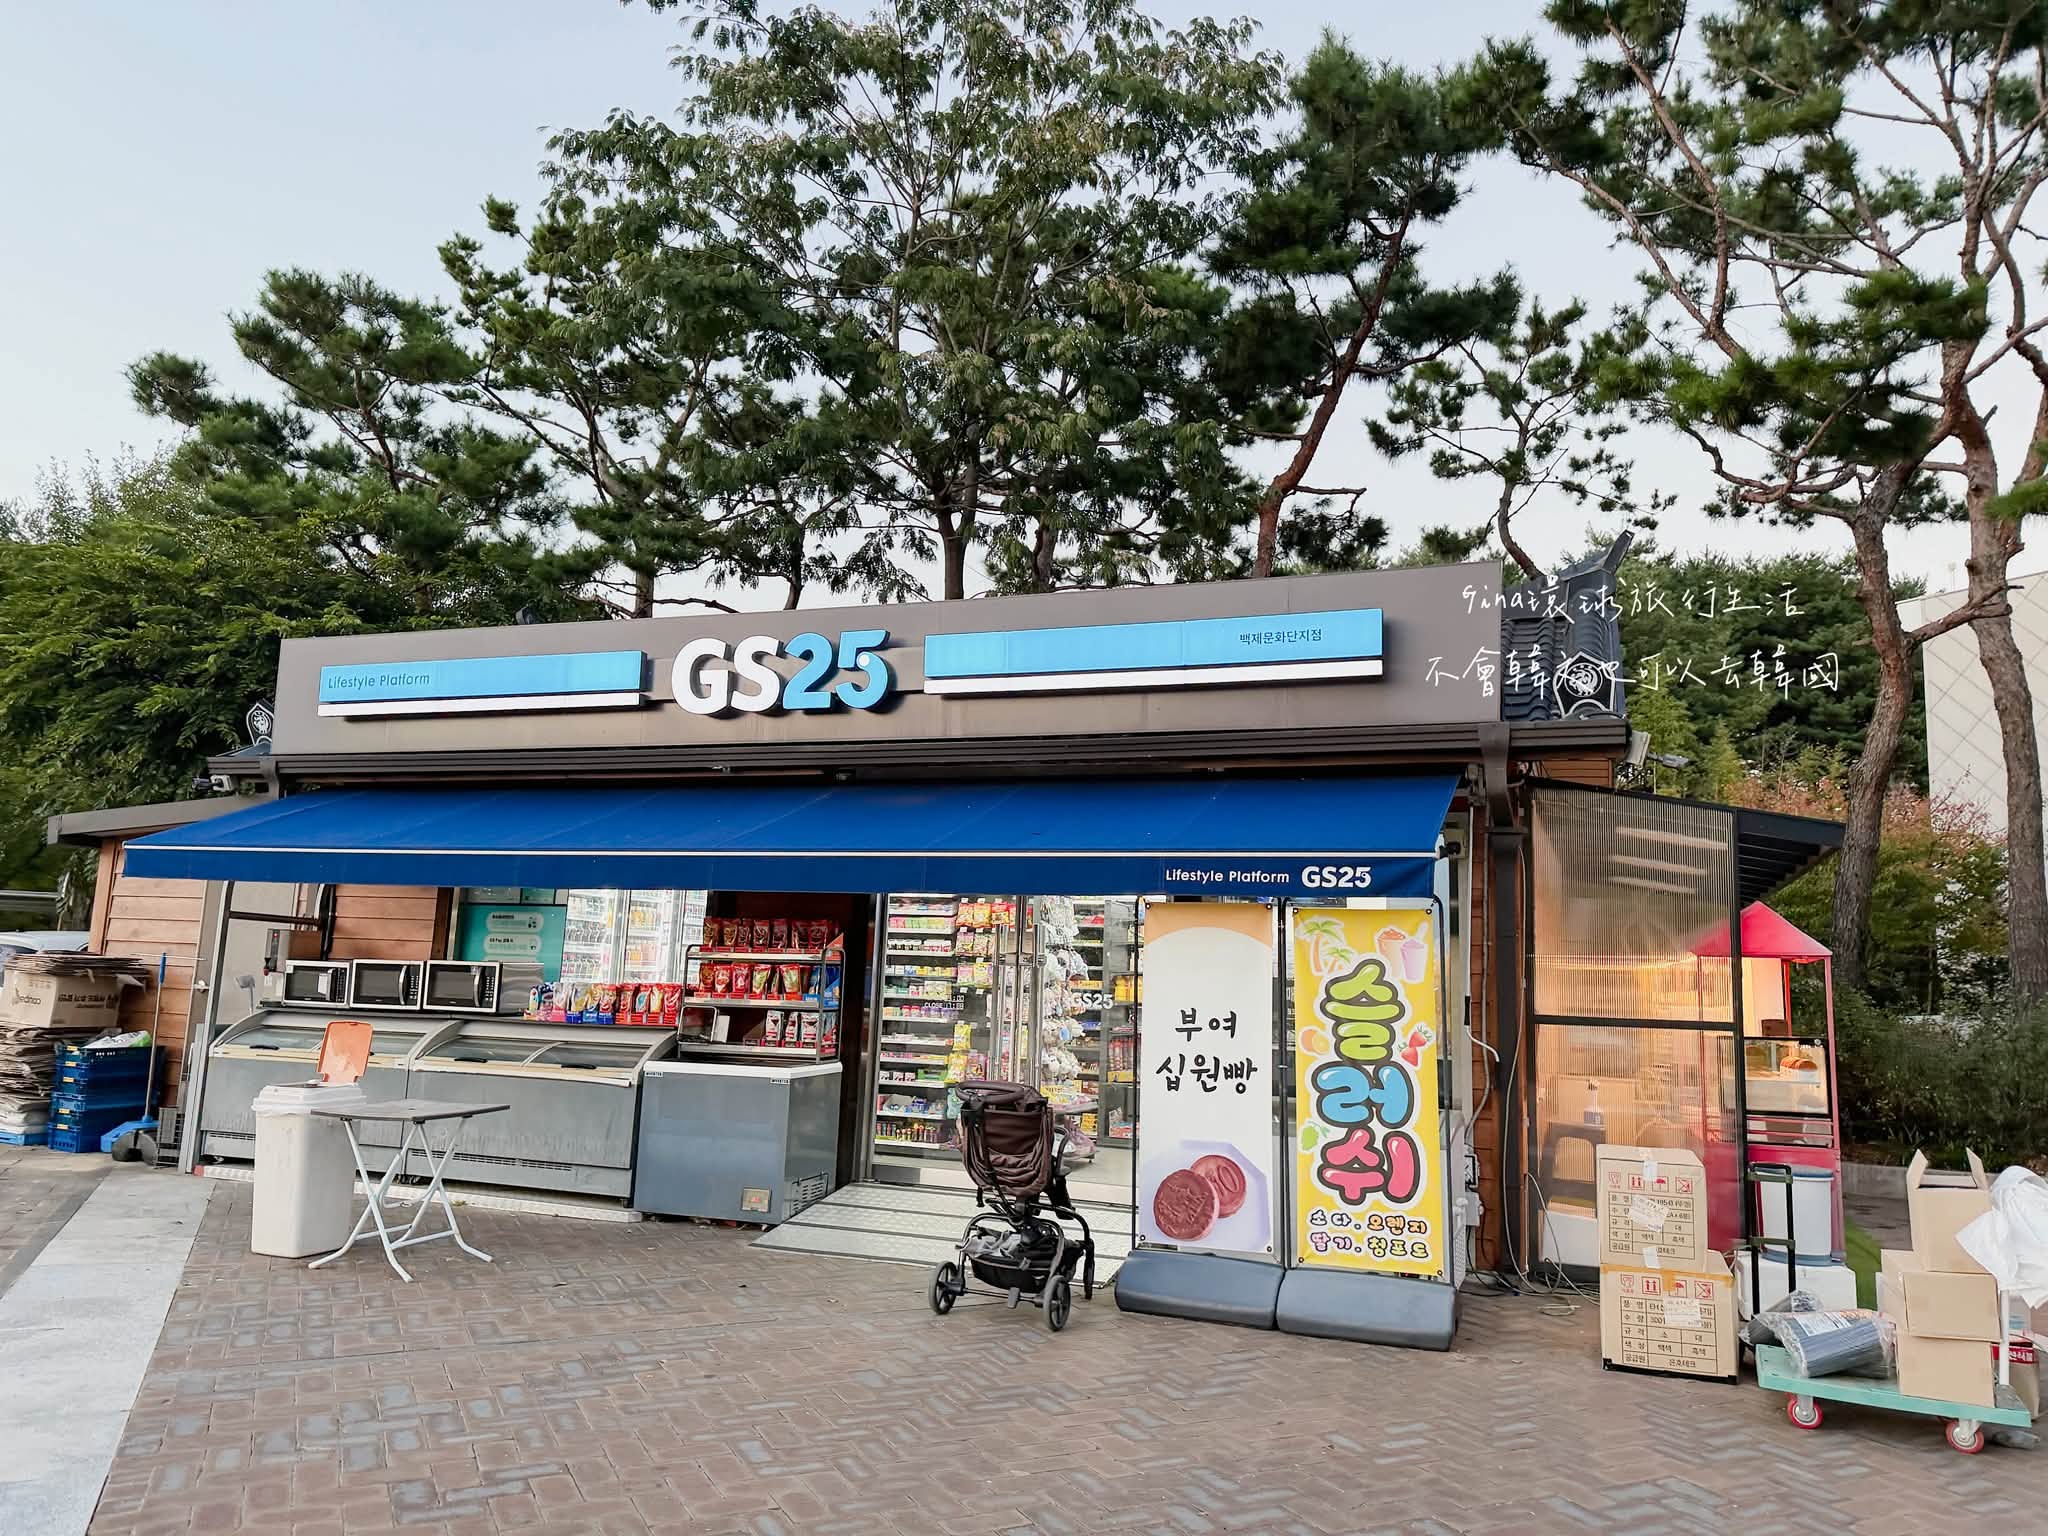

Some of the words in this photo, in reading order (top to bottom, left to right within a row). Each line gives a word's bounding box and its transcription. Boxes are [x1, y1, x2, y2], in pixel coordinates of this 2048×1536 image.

[1240, 628, 1322, 645] 백제문화단지점
[328, 675, 376, 690] Lifestyle
[379, 673, 430, 687] Platform
[671, 630, 889, 715] GS25
[1165, 868, 1224, 885] Lifestyle
[1229, 869, 1290, 883] Platform
[1301, 866, 1372, 888] GS25
[1071, 992, 1114, 1010] GS25
[1175, 1007, 1237, 1042] 부여
[1155, 1054, 1257, 1094] 십원빵
[1312, 958, 1420, 1204] 슬러쉬
